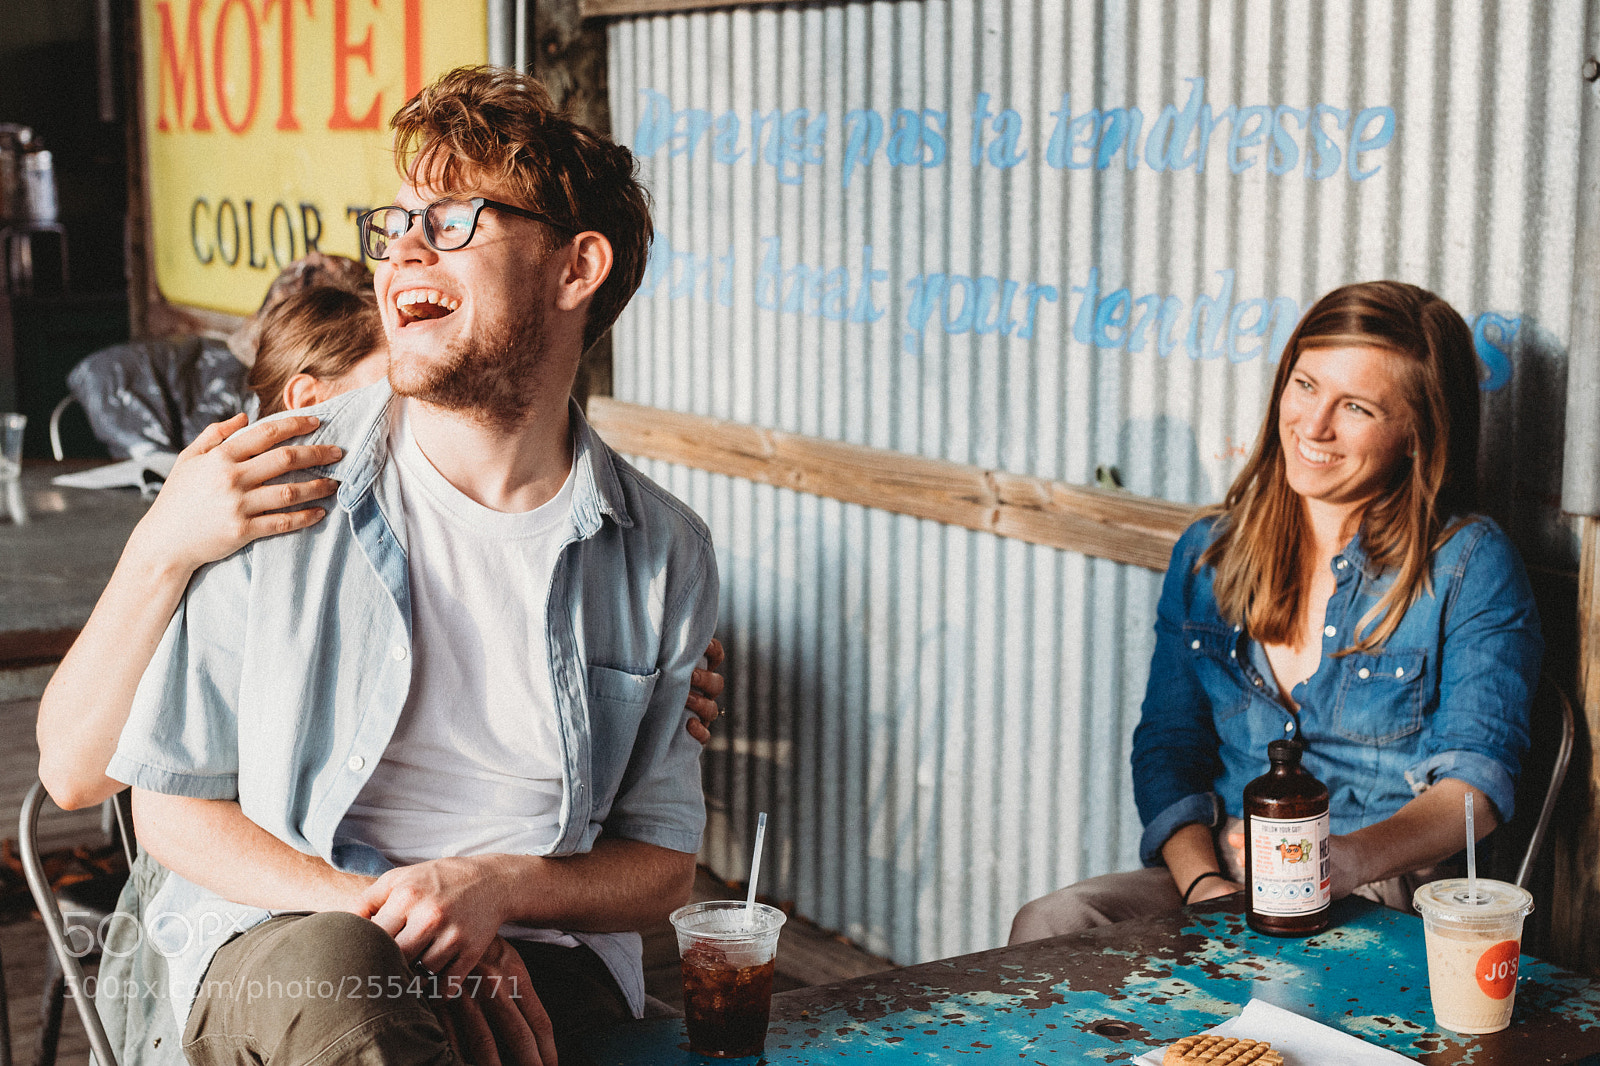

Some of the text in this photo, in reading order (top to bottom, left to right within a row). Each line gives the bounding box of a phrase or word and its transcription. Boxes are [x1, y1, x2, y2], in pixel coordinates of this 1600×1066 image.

[843, 106, 948, 188] pas
[970, 91, 1029, 170] ta
[1045, 76, 1395, 182] tendresse
[190, 197, 321, 269] COLOR
[903, 270, 1059, 355] your
[1072, 266, 1521, 392] tenders
[1485, 957, 1518, 981] JO'S
